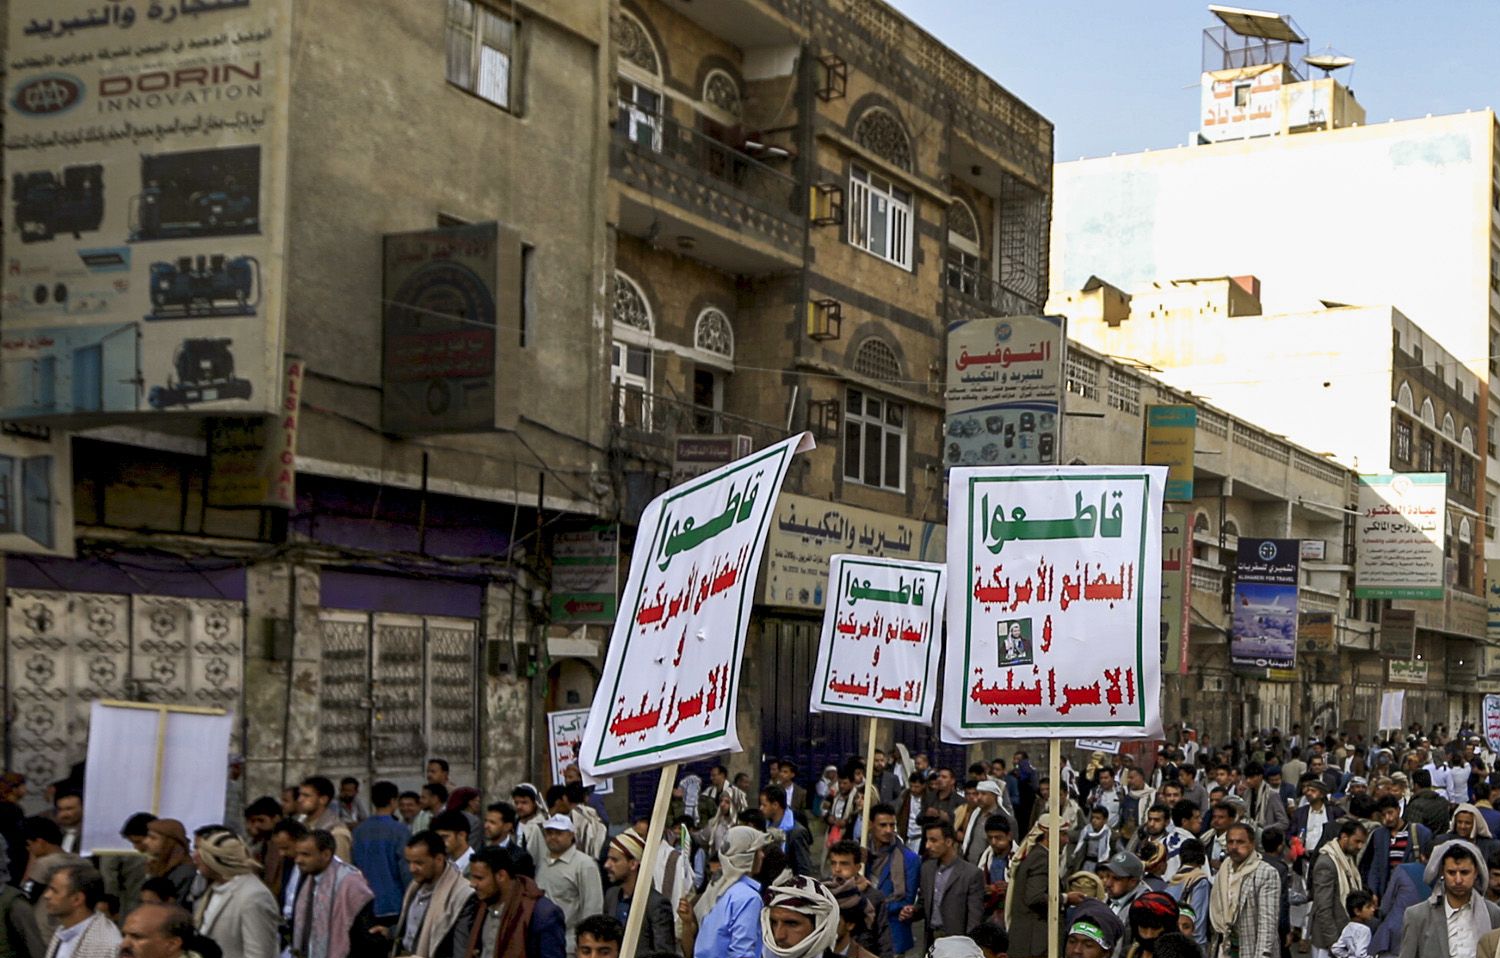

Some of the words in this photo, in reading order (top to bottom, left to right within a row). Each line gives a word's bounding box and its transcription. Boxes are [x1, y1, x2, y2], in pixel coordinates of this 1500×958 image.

[98, 84, 262, 113] INNOVATION
[100, 62, 262, 97] DORIN
[955, 340, 1051, 371] التوفيق
[656, 470, 765, 572] قاطعوا
[778, 503, 856, 550] والتكييف
[858, 524, 913, 558] للتبريد
[982, 490, 1125, 556] قاطعوا
[636, 560, 700, 636] الأمريكية
[693, 543, 751, 617] البضائع
[844, 570, 926, 607] قاطعوا
[973, 555, 1056, 613] الأمريكية
[1060, 558, 1136, 613] البضائع
[837, 608, 885, 640] الأمريكية
[887, 619, 929, 645] البضائع
[1041, 615, 1054, 654] و
[674, 624, 688, 668] و
[873, 646, 882, 668] و
[609, 660, 731, 747] الإسرائيلية
[829, 671, 923, 707] الإسرائيلية
[970, 663, 1137, 718] الإسرائيلية
